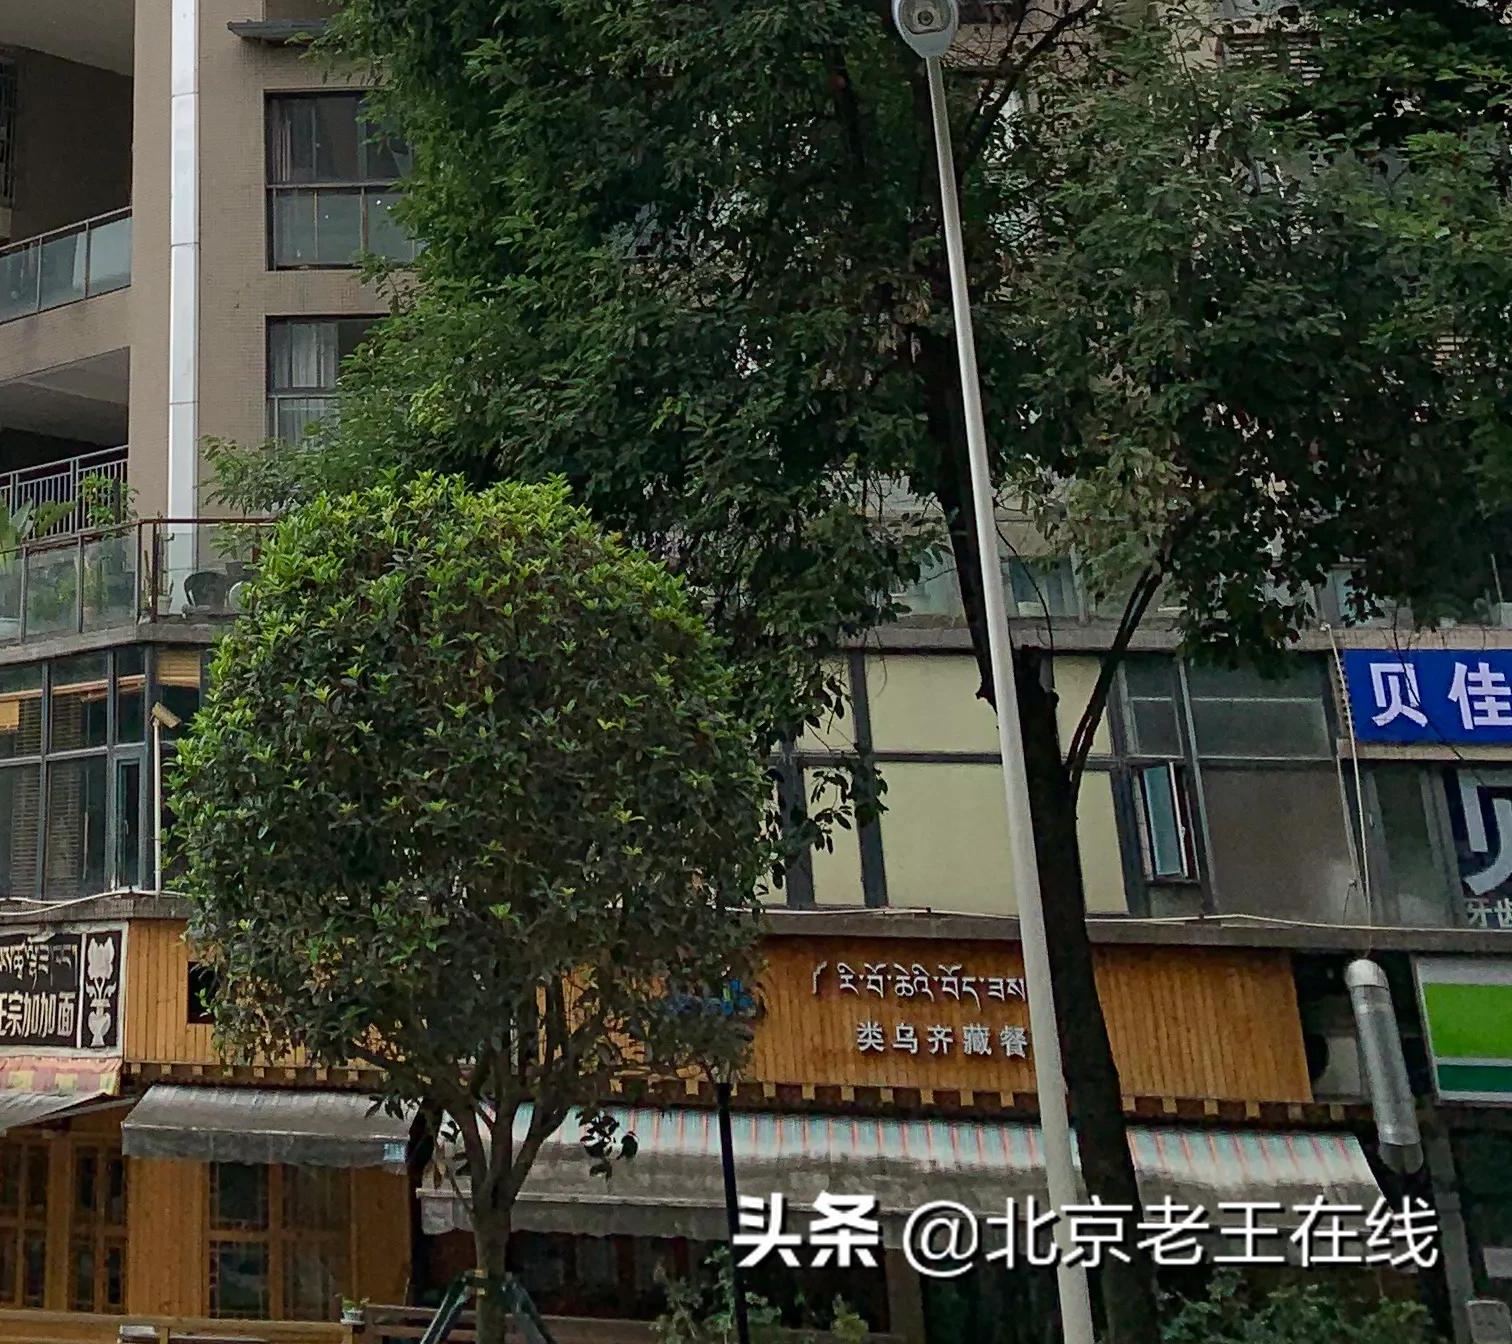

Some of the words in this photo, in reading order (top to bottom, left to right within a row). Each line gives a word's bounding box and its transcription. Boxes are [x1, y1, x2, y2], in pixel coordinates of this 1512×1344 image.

[856, 1020, 1028, 1058] 类乌齐藏餐
